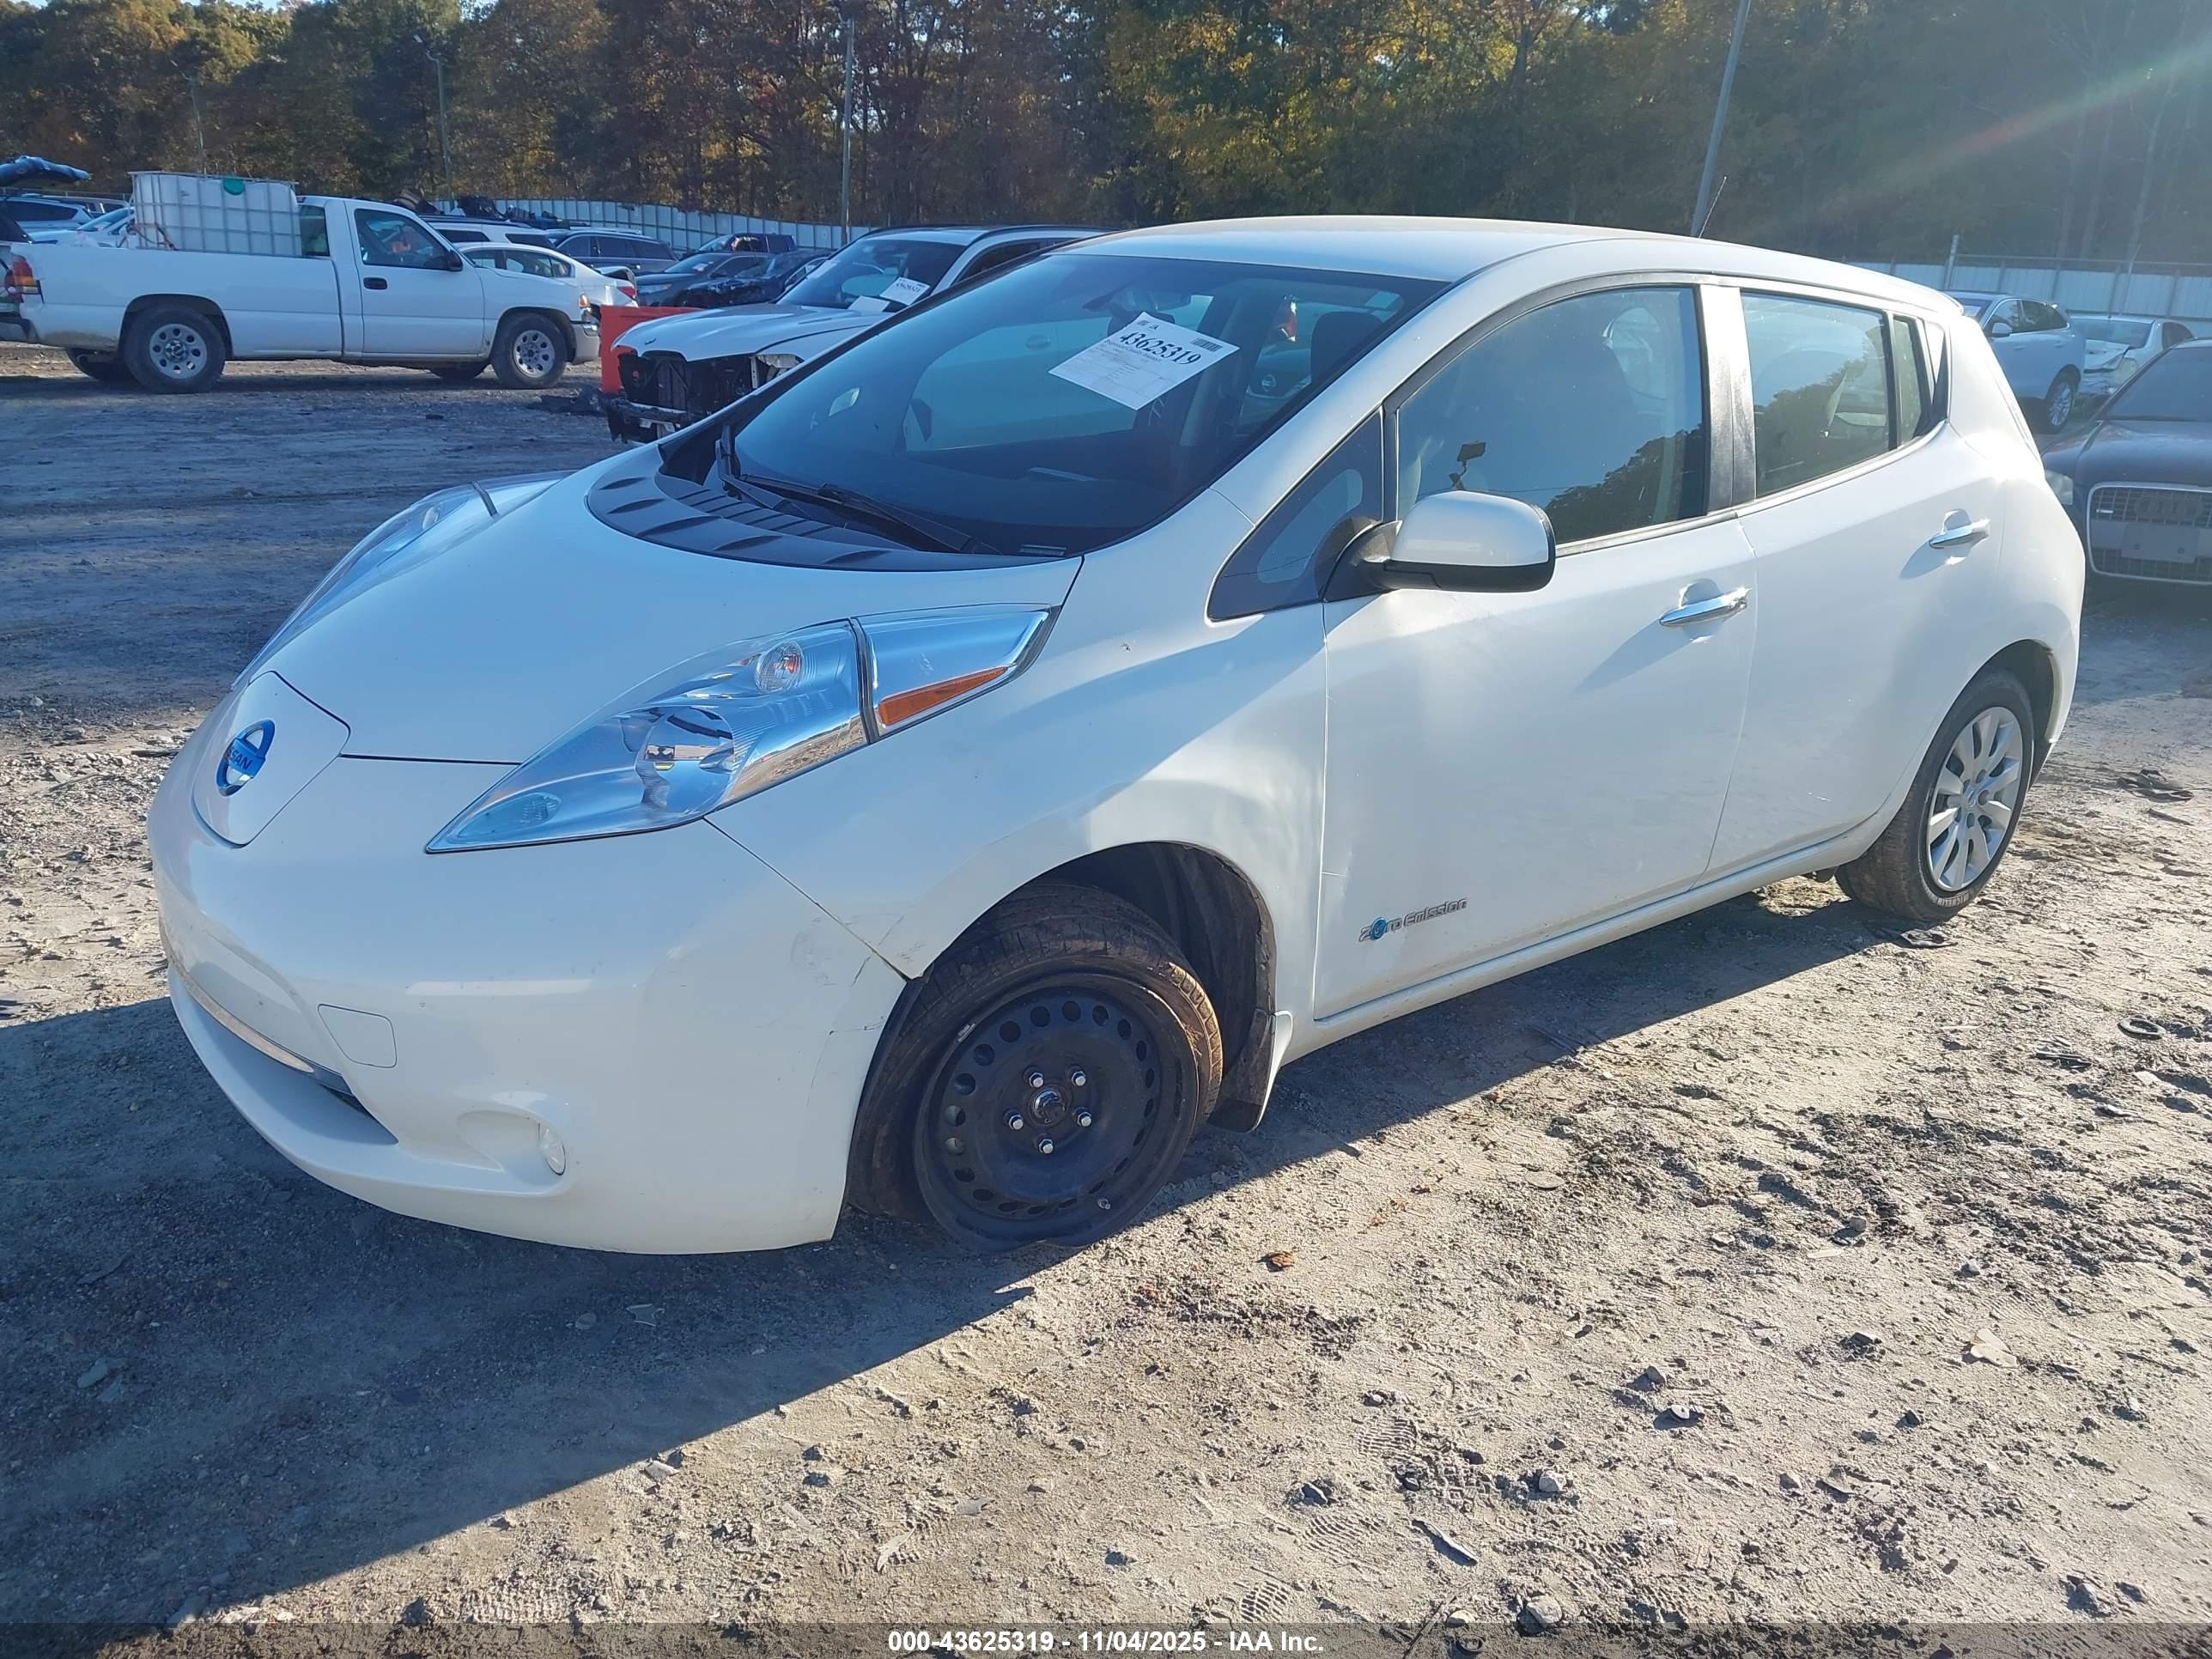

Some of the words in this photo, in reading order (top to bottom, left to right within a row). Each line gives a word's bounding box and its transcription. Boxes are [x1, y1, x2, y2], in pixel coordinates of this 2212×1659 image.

[1120, 331, 1201, 365] 43625319
[1358, 916, 1402, 942] Zero
[1403, 897, 1468, 927] Emission
